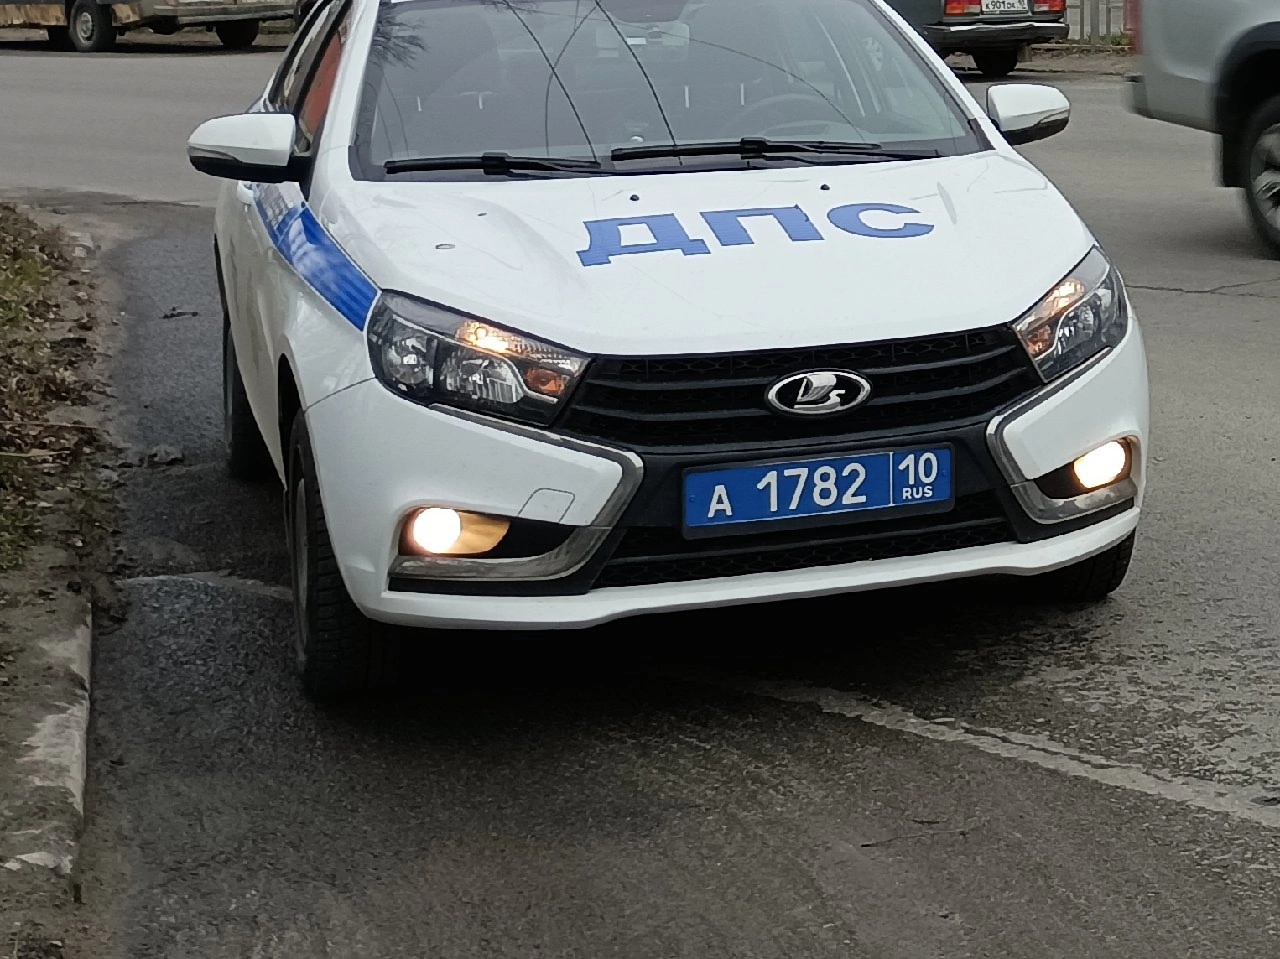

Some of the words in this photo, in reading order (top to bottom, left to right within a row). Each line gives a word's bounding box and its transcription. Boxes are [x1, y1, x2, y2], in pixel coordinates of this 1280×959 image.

[576, 202, 935, 267] ДПС
[708, 485, 732, 517] А
[757, 462, 867, 512] 1782
[898, 452, 938, 485] 10
[903, 486, 933, 500] RUS
